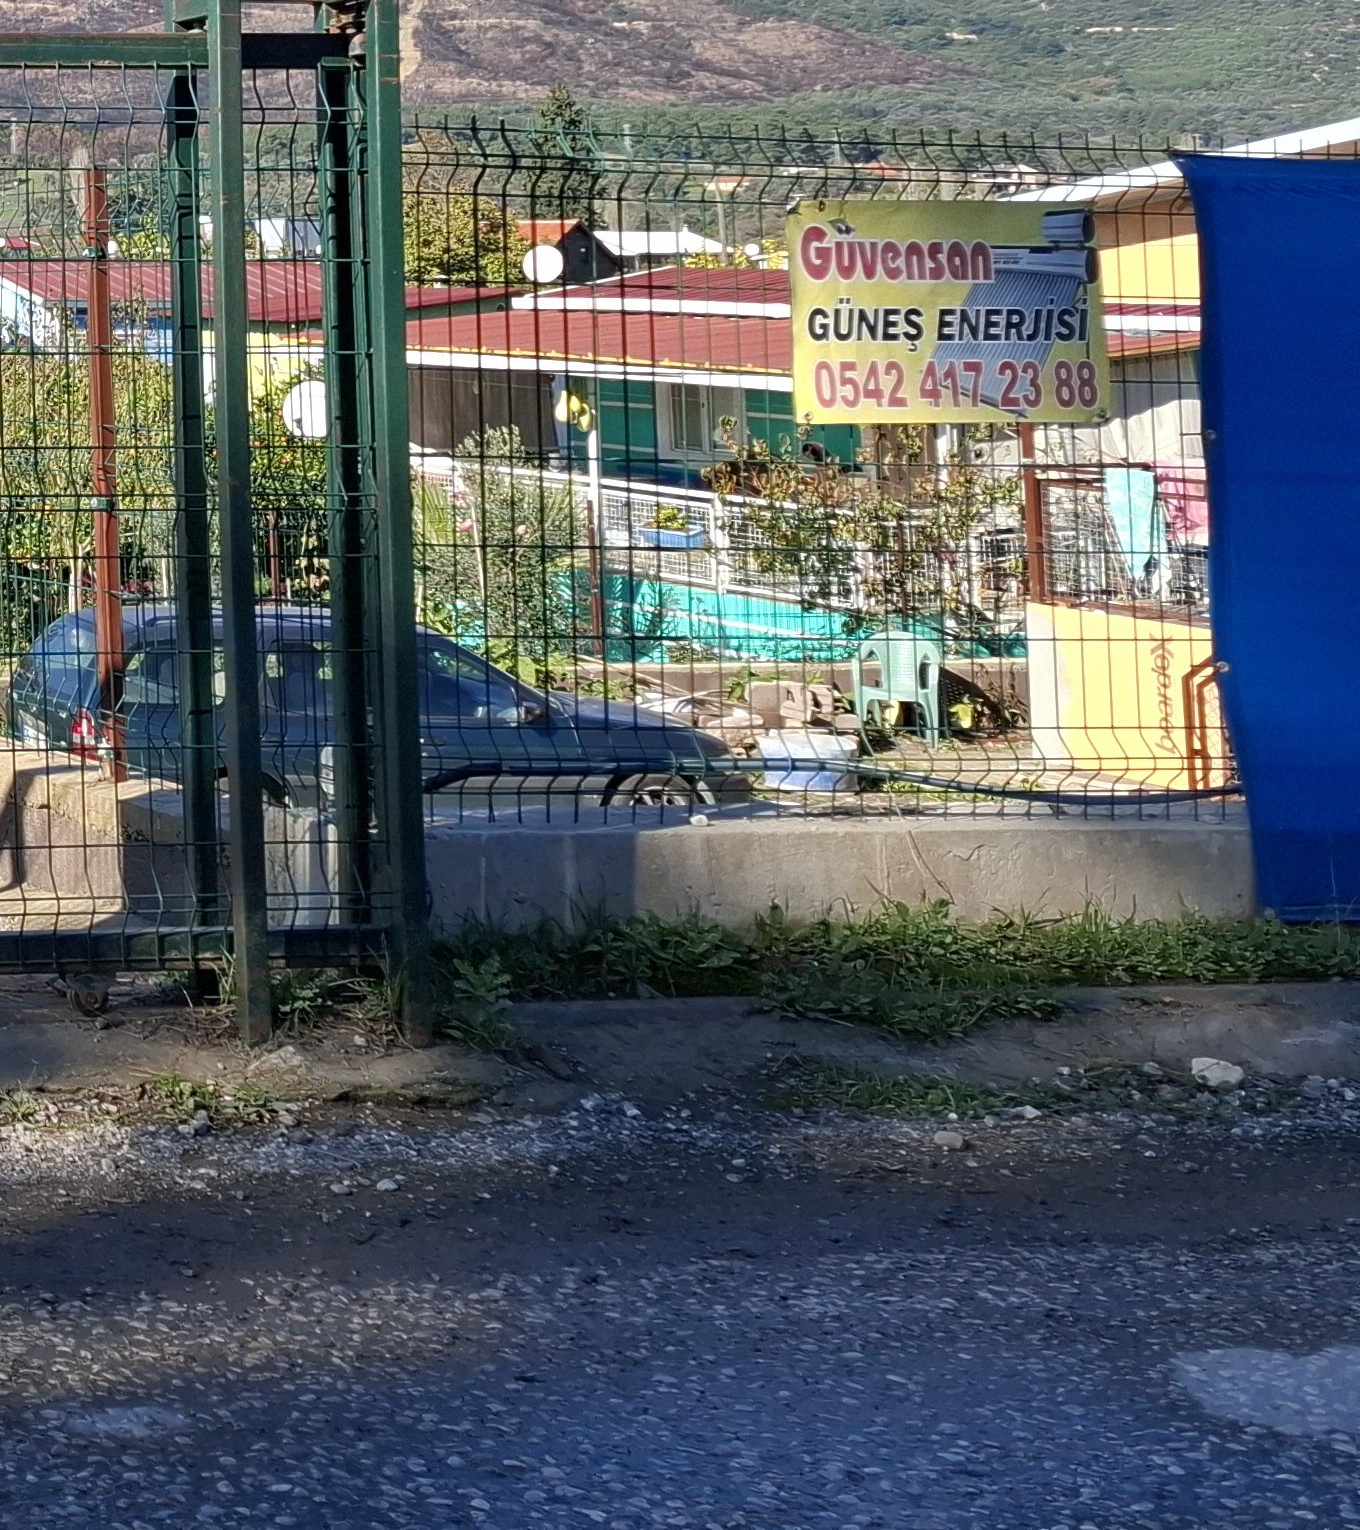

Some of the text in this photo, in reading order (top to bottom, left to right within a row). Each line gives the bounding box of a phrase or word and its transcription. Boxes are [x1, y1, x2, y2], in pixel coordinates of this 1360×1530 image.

[799, 223, 995, 283] Güvensan
[807, 297, 1091, 353] GÜNEŞ ENERJİSİ
[814, 359, 1099, 410] 0542 417 23 88
